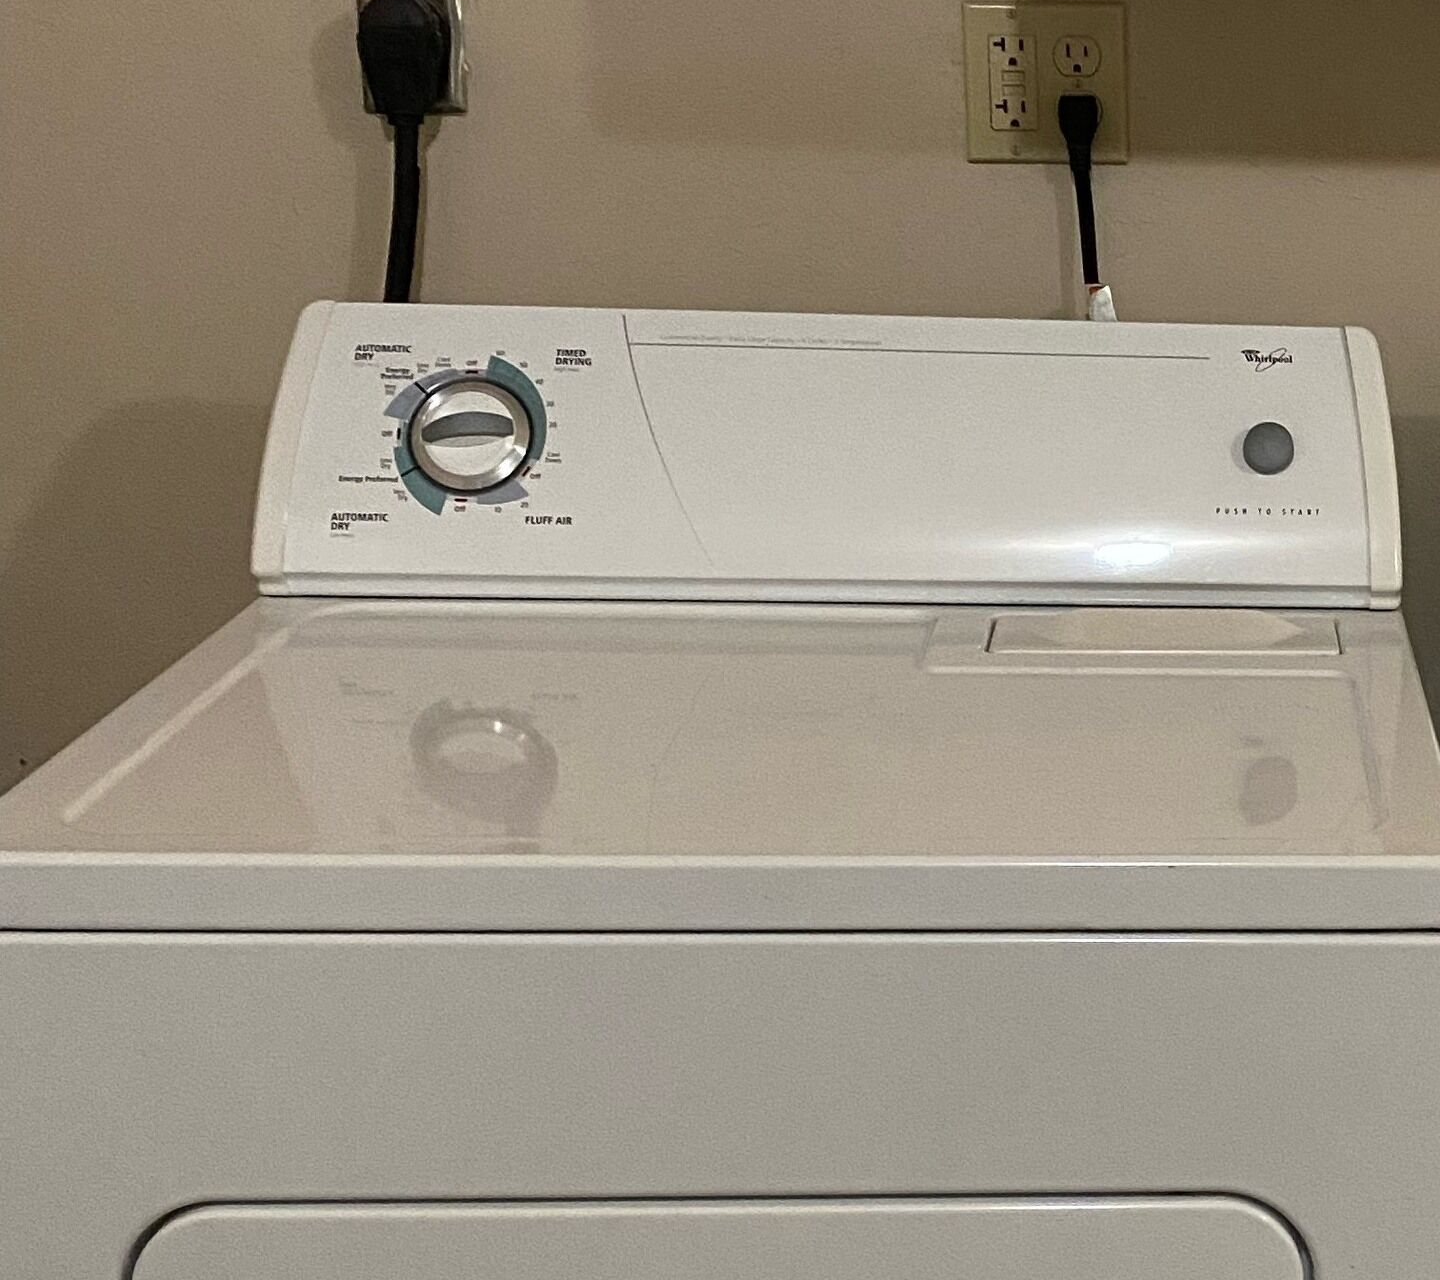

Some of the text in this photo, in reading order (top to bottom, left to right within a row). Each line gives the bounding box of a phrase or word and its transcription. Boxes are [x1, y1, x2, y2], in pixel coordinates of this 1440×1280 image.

[355, 344, 412, 353] AUTOMATIC
[556, 348, 587, 357] TIMED
[354, 353, 375, 361] DRY
[555, 357, 592, 366] DRYING
[1241, 349, 1293, 368] Whirlpool
[1215, 507, 1247, 515] PUSH
[1281, 508, 1320, 516] START
[330, 513, 389, 522] AUTOMATIC
[524, 516, 573, 525] FLUFF AIR
[330, 522, 351, 531] DRY
